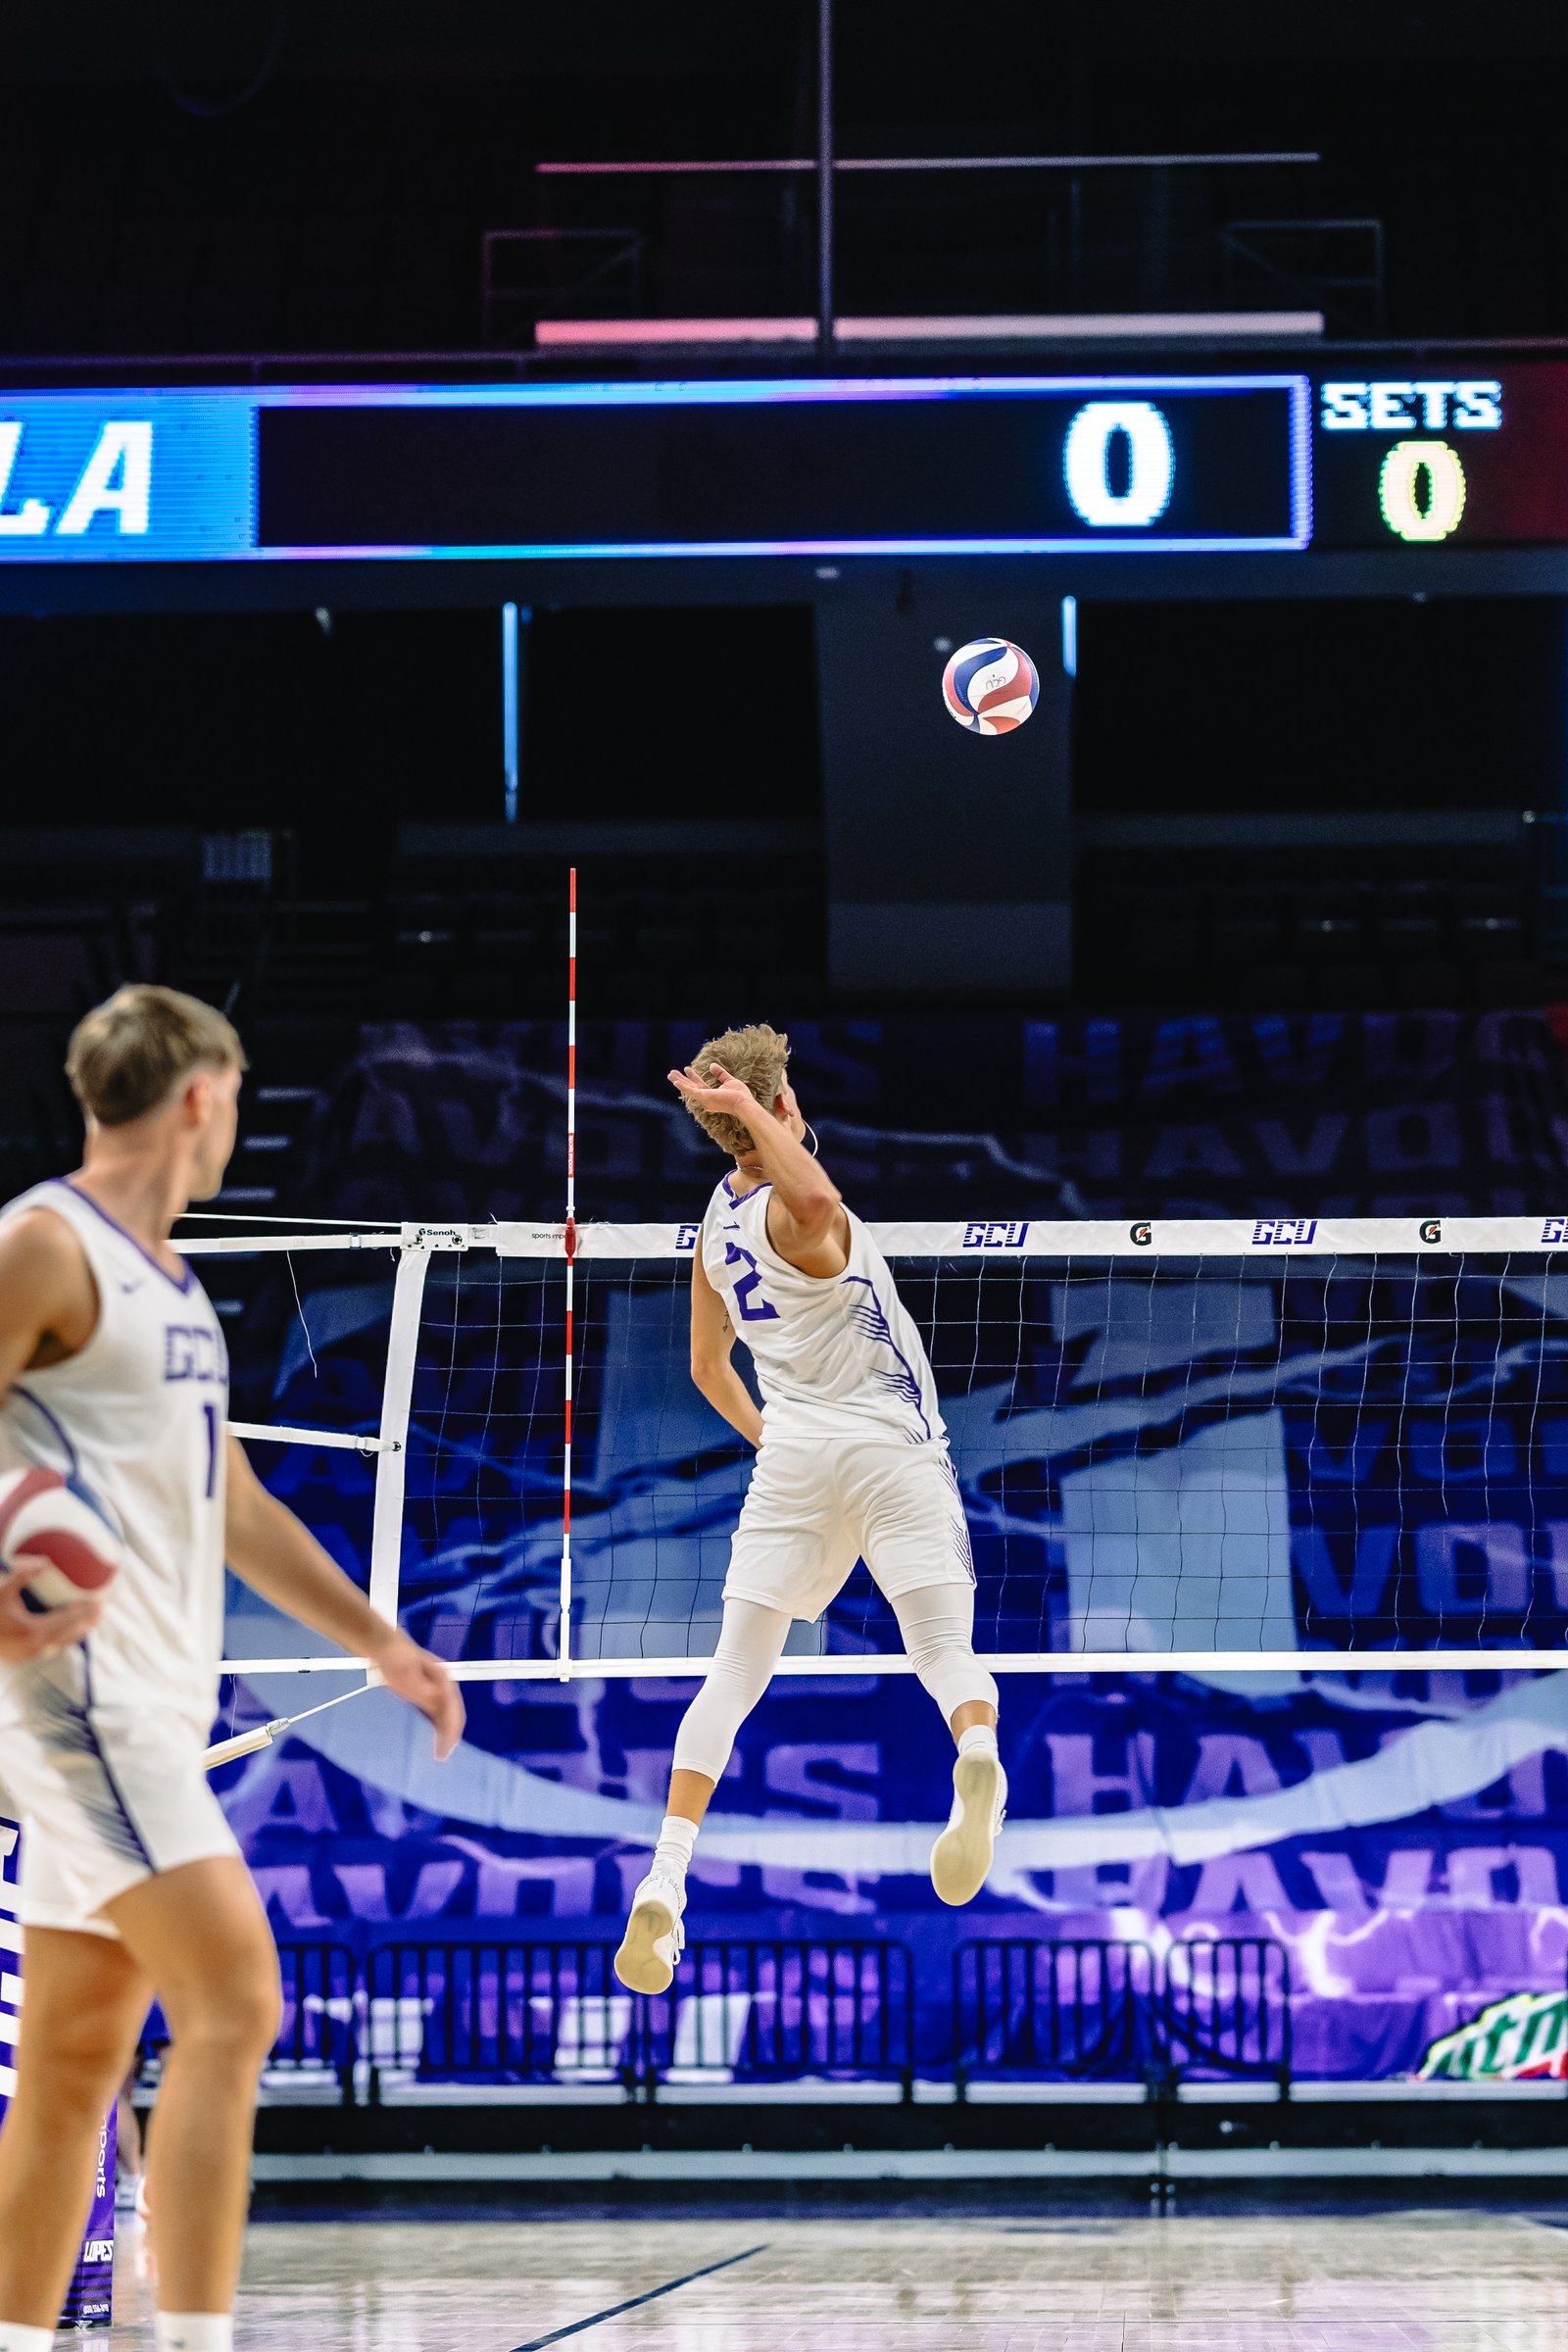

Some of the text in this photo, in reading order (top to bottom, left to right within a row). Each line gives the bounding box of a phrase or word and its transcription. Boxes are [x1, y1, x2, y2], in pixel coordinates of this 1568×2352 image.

[1322, 380, 1501, 429] SETS
[1062, 401, 1176, 527] 0
[1379, 441, 1466, 541] 0
[962, 1223, 1030, 1248] GCU
[1130, 1222, 1152, 1246] G
[1252, 1220, 1318, 1245] GCU
[1419, 1219, 1442, 1244] G
[725, 1242, 780, 1320] 2
[204, 1404, 216, 1498] 1
[83, 2240, 114, 2262] LOPES
